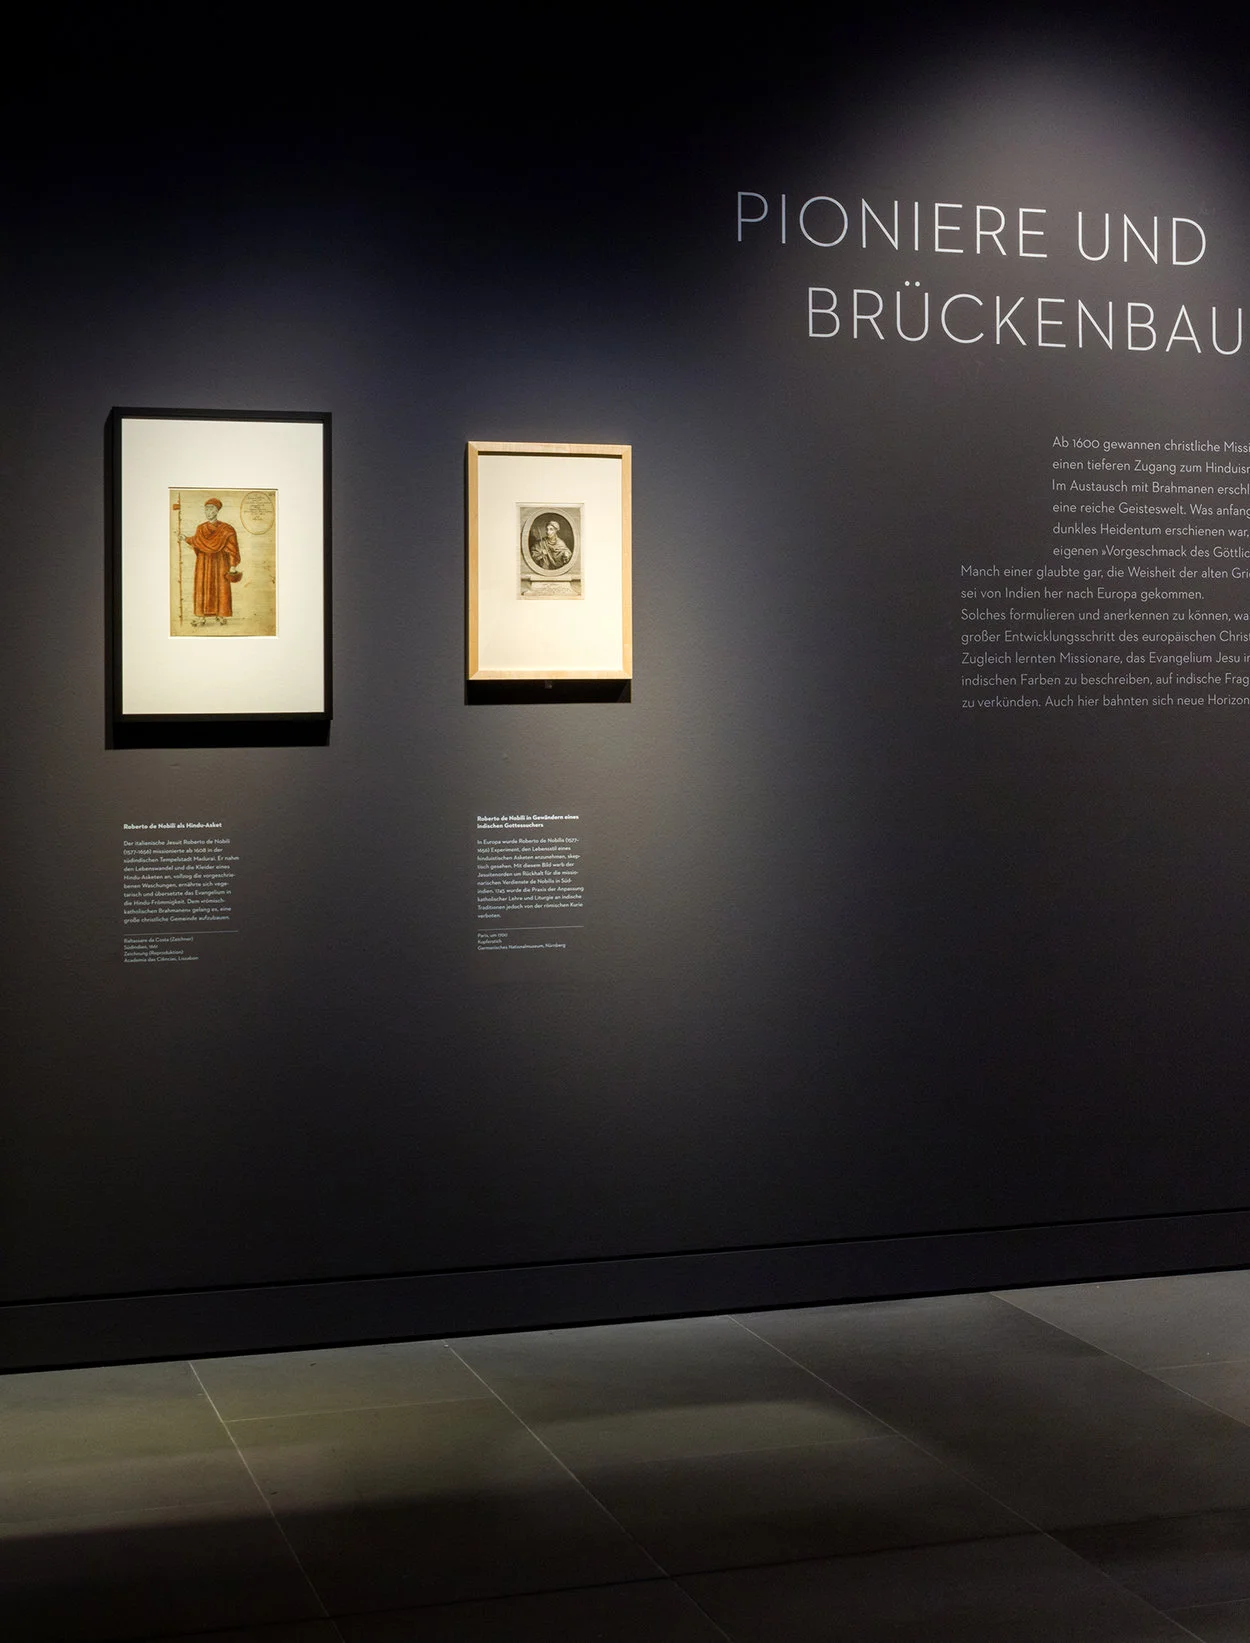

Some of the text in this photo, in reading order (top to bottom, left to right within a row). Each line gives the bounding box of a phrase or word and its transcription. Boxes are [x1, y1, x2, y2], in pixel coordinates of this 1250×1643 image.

[736, 191, 1208, 267] PIONIERE UND
[1052, 436, 1069, 448] Ab
[1072, 437, 1100, 449] 1600
[1102, 441, 1161, 452] gewannen
[1164, 439, 1220, 452] christliche
[1052, 458, 1083, 470] einen
[1087, 457, 1130, 471] tieferen
[1134, 459, 1176, 475] Zugang
[1179, 464, 1202, 473] zum
[1052, 479, 1066, 490] Im
[1069, 479, 1128, 492] Austausch
[1131, 481, 1148, 493] mit
[1152, 481, 1214, 494] Brahmanen
[1052, 501, 1077, 513] eine
[1080, 501, 1115, 513] reiche
[1118, 501, 1186, 515] Geisteswelt.
[1189, 503, 1213, 516] Was
[1052, 522, 1096, 535] dunkles
[1100, 523, 1161, 536] Heidentum
[1164, 523, 1225, 537] erschienen
[1227, 529, 1249, 538] war,
[1053, 545, 1098, 559] eigenen
[1189, 545, 1210, 558] des
[961, 564, 1000, 577] Manch
[1003, 566, 1032, 577] einer
[1036, 565, 1080, 580] glaubte
[1083, 569, 1103, 580] gar,
[1106, 565, 1124, 578] die
[1127, 565, 1176, 578] Weisheit
[1178, 566, 1198, 578] der
[1201, 566, 1228, 579] alten
[961, 586, 1204, 602] sei von Indien her nach Europa gekommen.
[961, 608, 1006, 620] Solches
[1009, 607, 1075, 620] formulieren
[1078, 608, 1100, 620] und
[1103, 608, 1169, 621] anerkennen
[1172, 612, 1184, 621] zu
[1188, 608, 1231, 622] können,
[961, 629, 1000, 645] großer
[1004, 629, 1115, 645] Entwicklungsschritt
[1118, 629, 1139, 642] des
[1141, 630, 1216, 644] europäischen
[961, 651, 1011, 667] Zugleich
[1015, 651, 1055, 664] lernten
[1059, 652, 1122, 664] Missionare,
[1125, 651, 1145, 663] das
[1149, 651, 1212, 666] Evangelium
[1215, 651, 1240, 663] Jesu
[961, 673, 1016, 686] indischen
[1020, 673, 1060, 686] Farben
[1064, 677, 1077, 685] zu
[1080, 672, 1152, 685] beschreiben,
[1155, 671, 1173, 685] auf
[1176, 672, 1221, 685] indische
[962, 700, 974, 708] zu
[977, 695, 1041, 708] verkünden.
[1044, 694, 1073, 707] Auch
[1077, 694, 1099, 707] hier
[1102, 694, 1148, 706] bahnten
[1152, 693, 1173, 706] sich
[1177, 697, 1204, 706] neue
